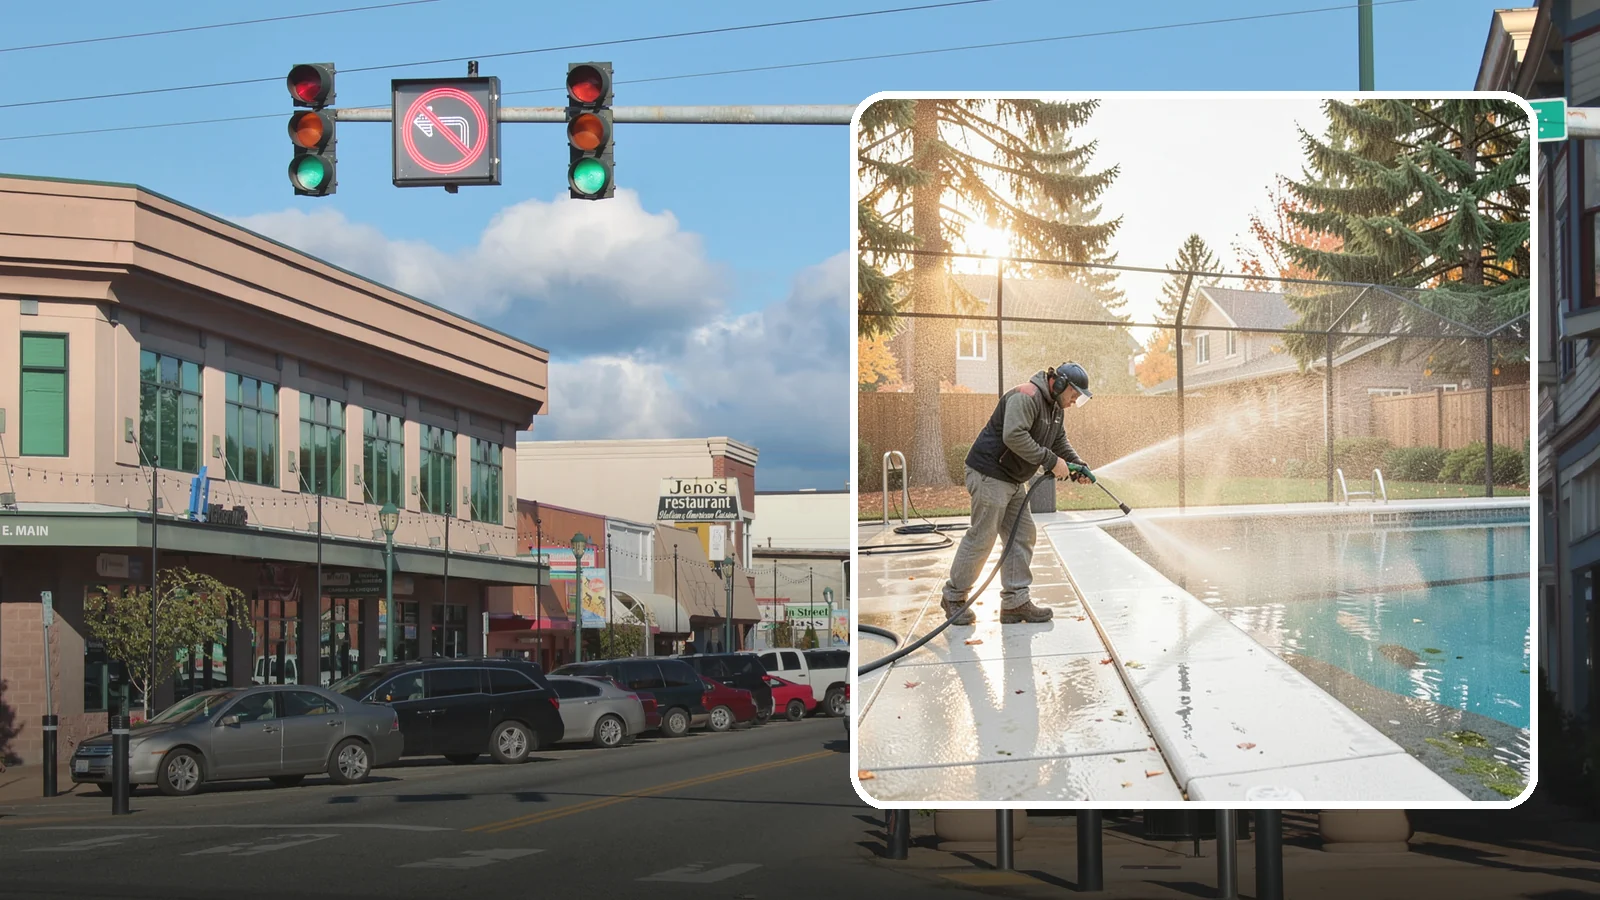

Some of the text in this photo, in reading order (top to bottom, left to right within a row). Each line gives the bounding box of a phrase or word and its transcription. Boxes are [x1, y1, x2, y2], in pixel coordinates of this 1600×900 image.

[670, 480, 728, 494] Jeno's
[665, 496, 731, 509] restaurant
[659, 510, 682, 519] Italian
[686, 510, 714, 519] American
[715, 510, 738, 519] Cuisine
[2, 525, 49, 536] E. MAIN
[797, 607, 828, 616] Street
